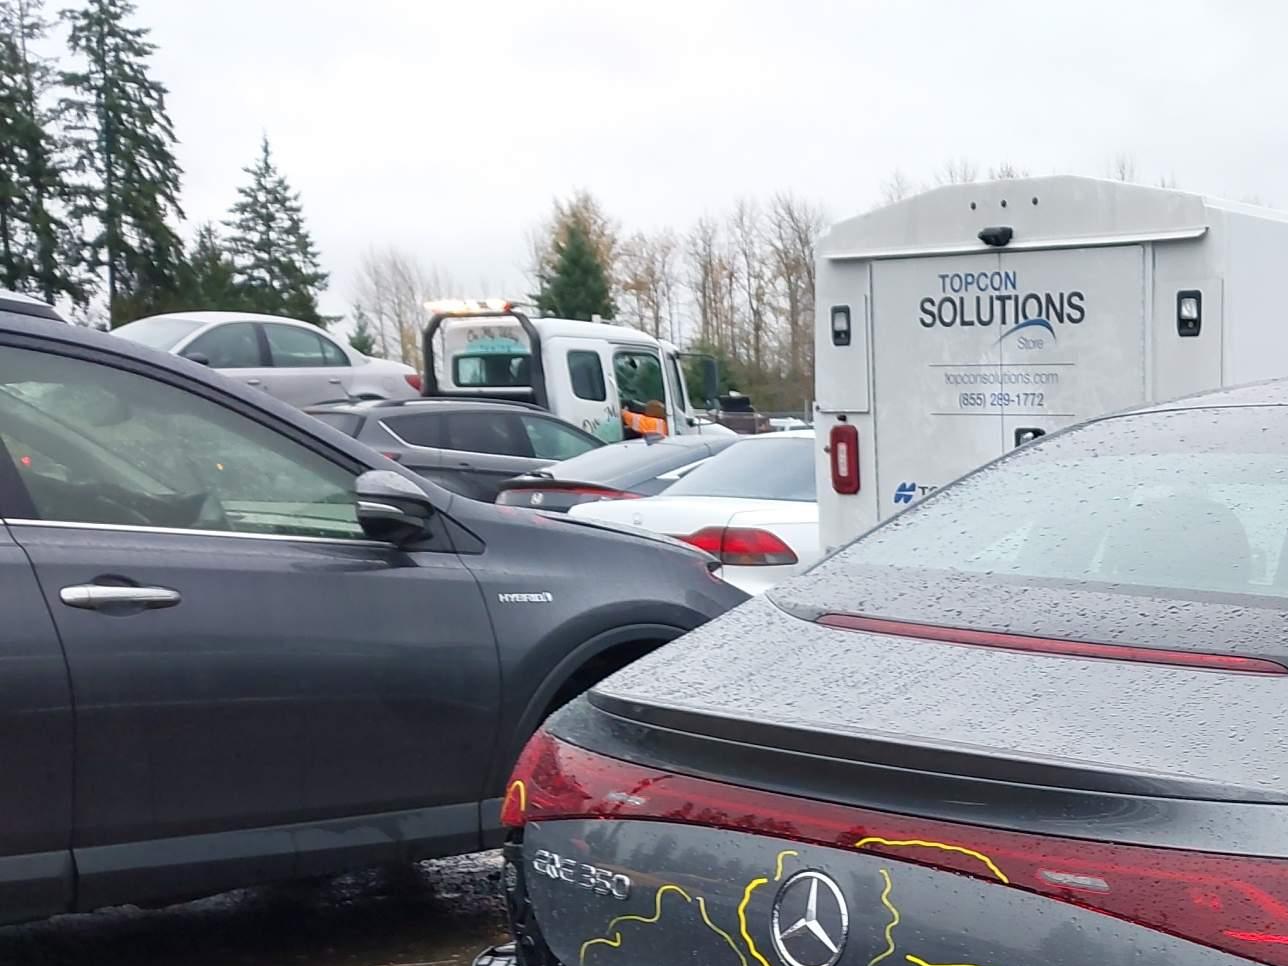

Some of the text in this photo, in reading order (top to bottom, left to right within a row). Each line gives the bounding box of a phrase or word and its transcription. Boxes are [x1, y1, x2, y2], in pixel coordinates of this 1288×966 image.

[938, 271, 1017, 293] TOPCON
[919, 291, 1085, 327] SOLUTIONS
[1017, 337, 1044, 350] Store
[944, 372, 1059, 387] topconsolutions.com
[959, 392, 1044, 408] (855) 289-1772
[498, 593, 543, 603] HYBRID
[578, 863, 631, 900] 350
